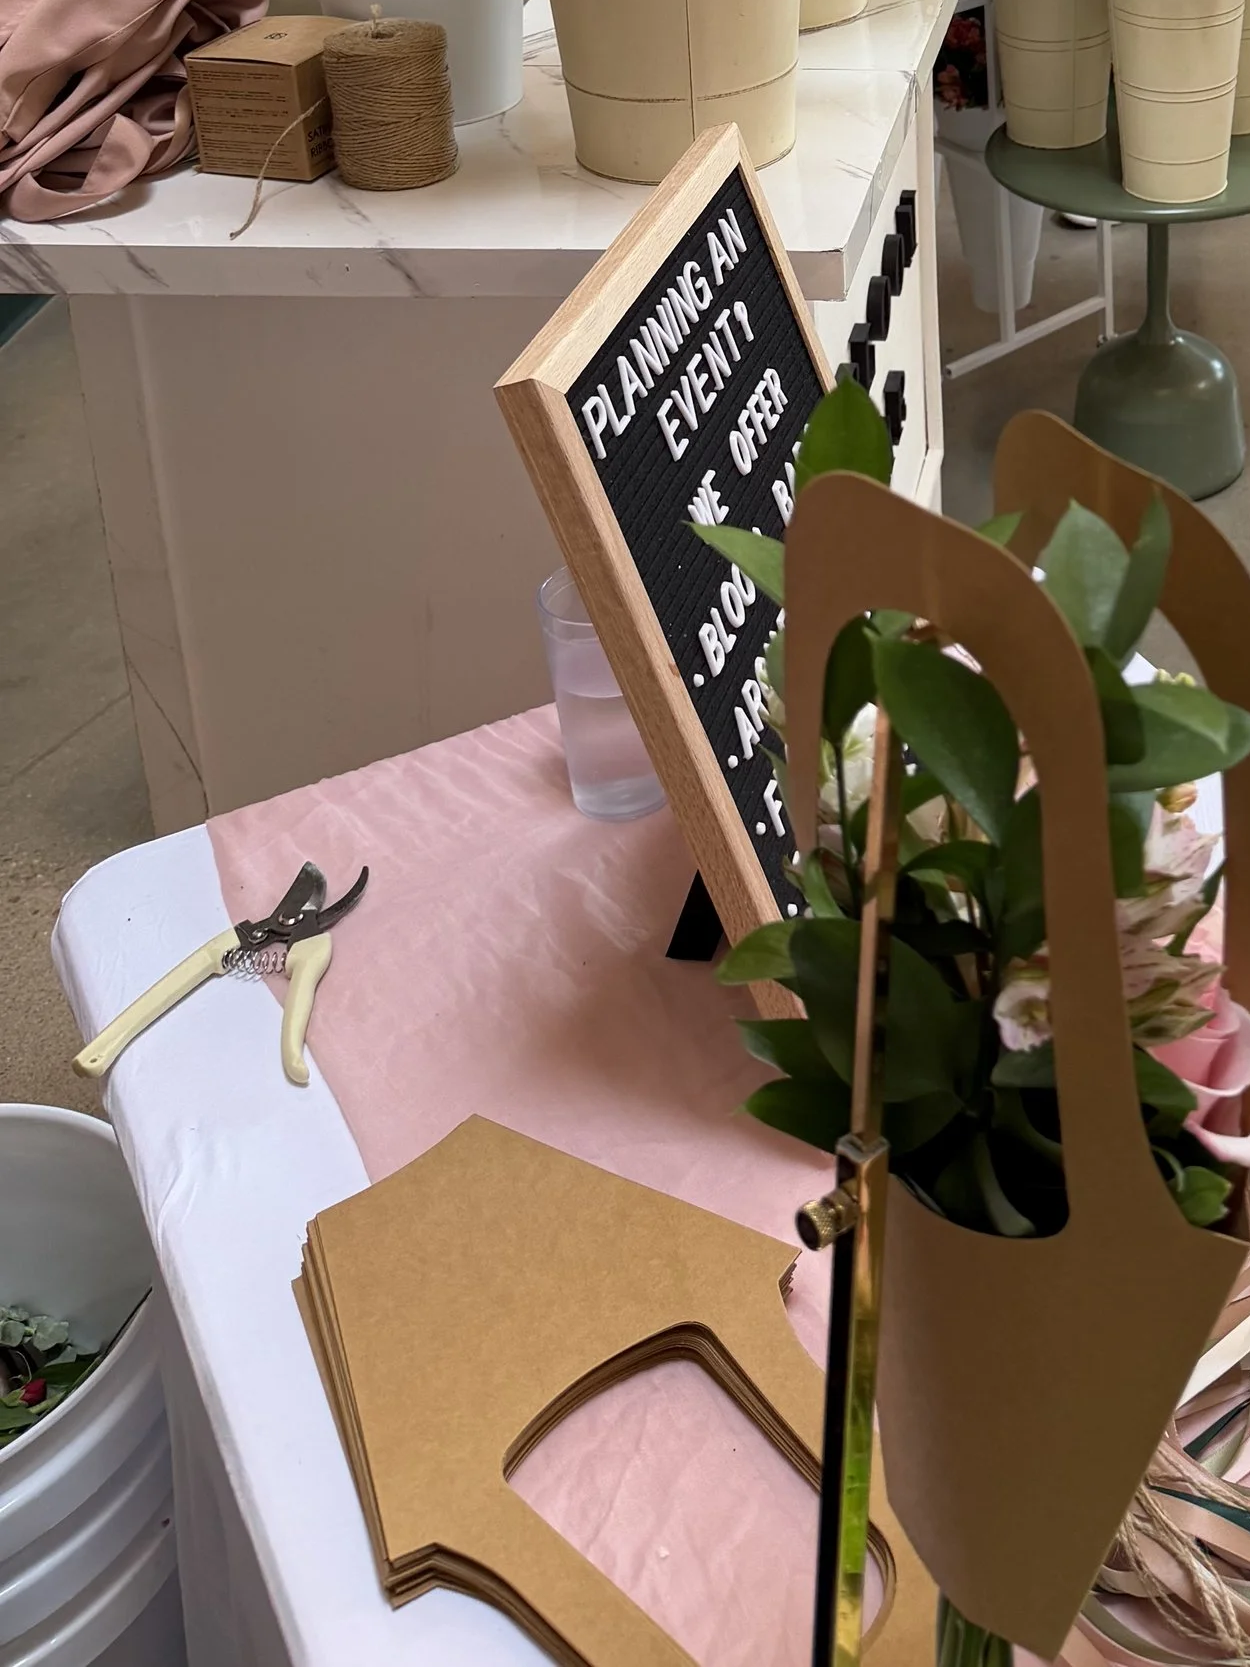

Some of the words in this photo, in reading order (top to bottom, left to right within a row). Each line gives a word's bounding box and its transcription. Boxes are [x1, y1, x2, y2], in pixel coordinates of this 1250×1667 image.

[581, 260, 713, 460] PLANNING
[706, 207, 748, 286] AN
[656, 300, 755, 462] EVENT?
[687, 469, 729, 527] WE
[729, 367, 789, 476] OFFER
[698, 527, 761, 677] BLOO
